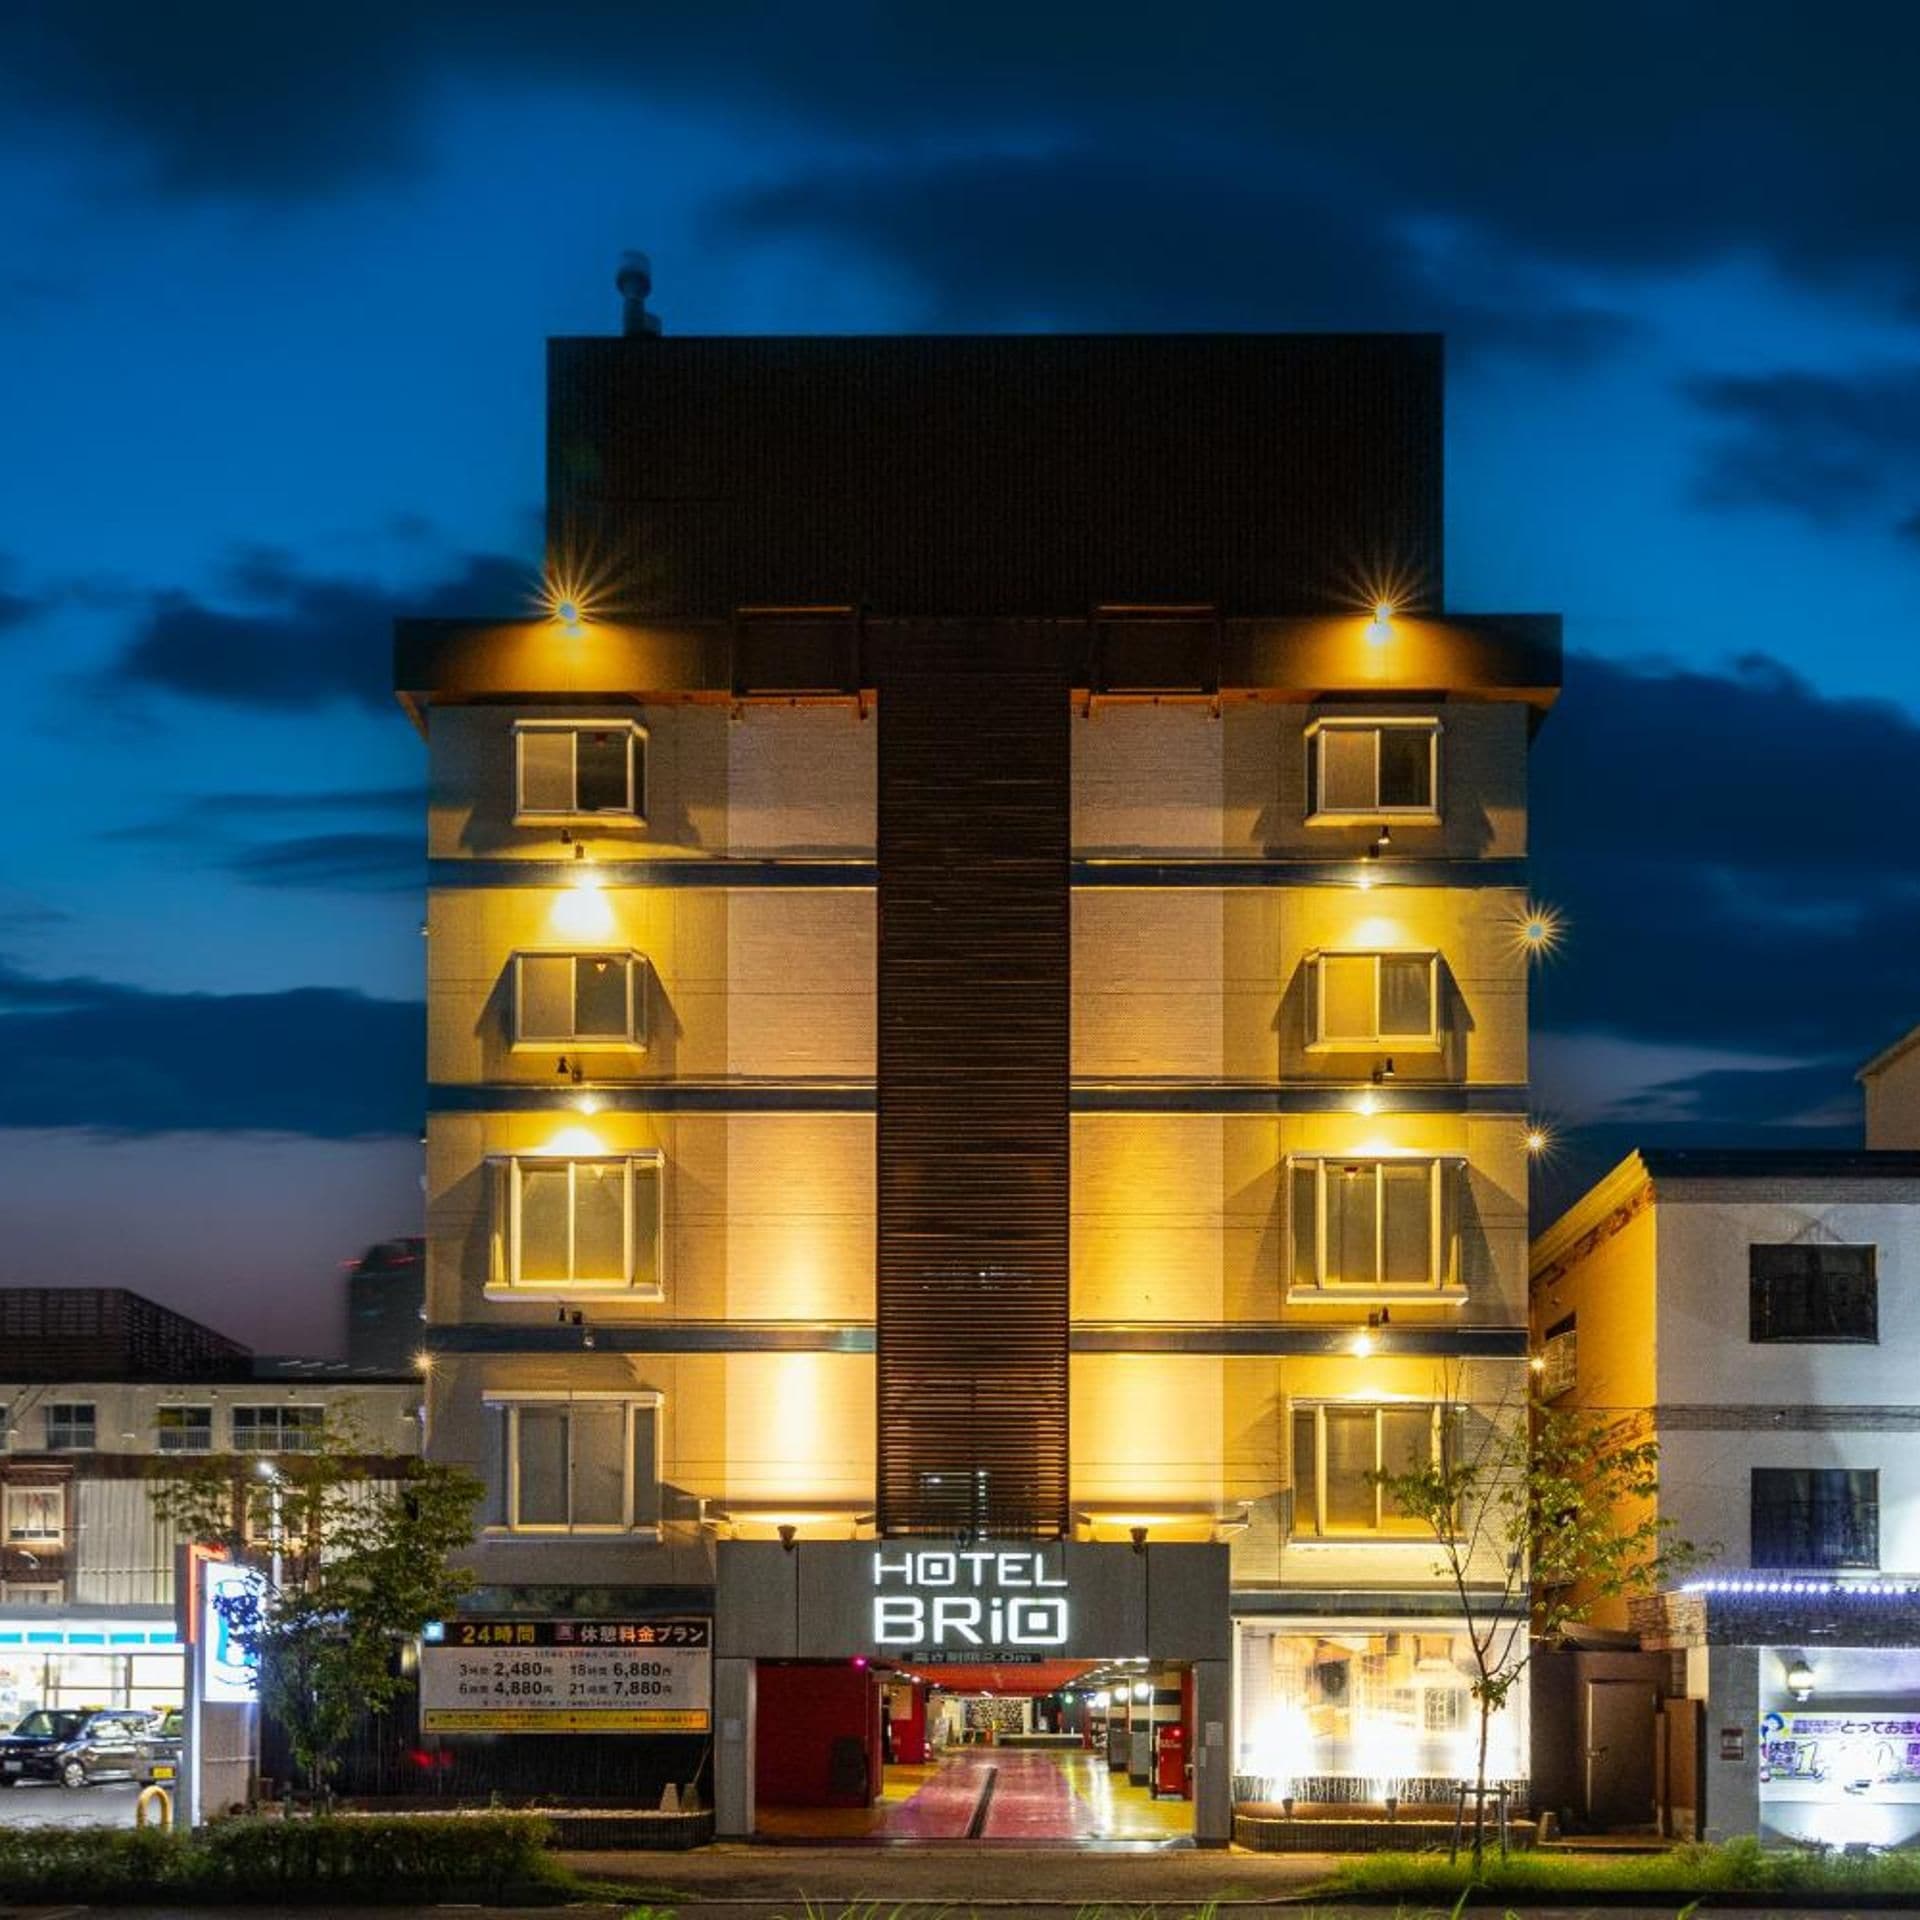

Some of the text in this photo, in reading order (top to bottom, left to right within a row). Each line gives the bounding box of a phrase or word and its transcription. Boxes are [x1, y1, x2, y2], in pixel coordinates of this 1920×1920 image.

[873, 1552, 1068, 1587] HOTEL
[462, 1624, 535, 1644] 24時間
[580, 1625, 704, 1643] 休憩料金プラン
